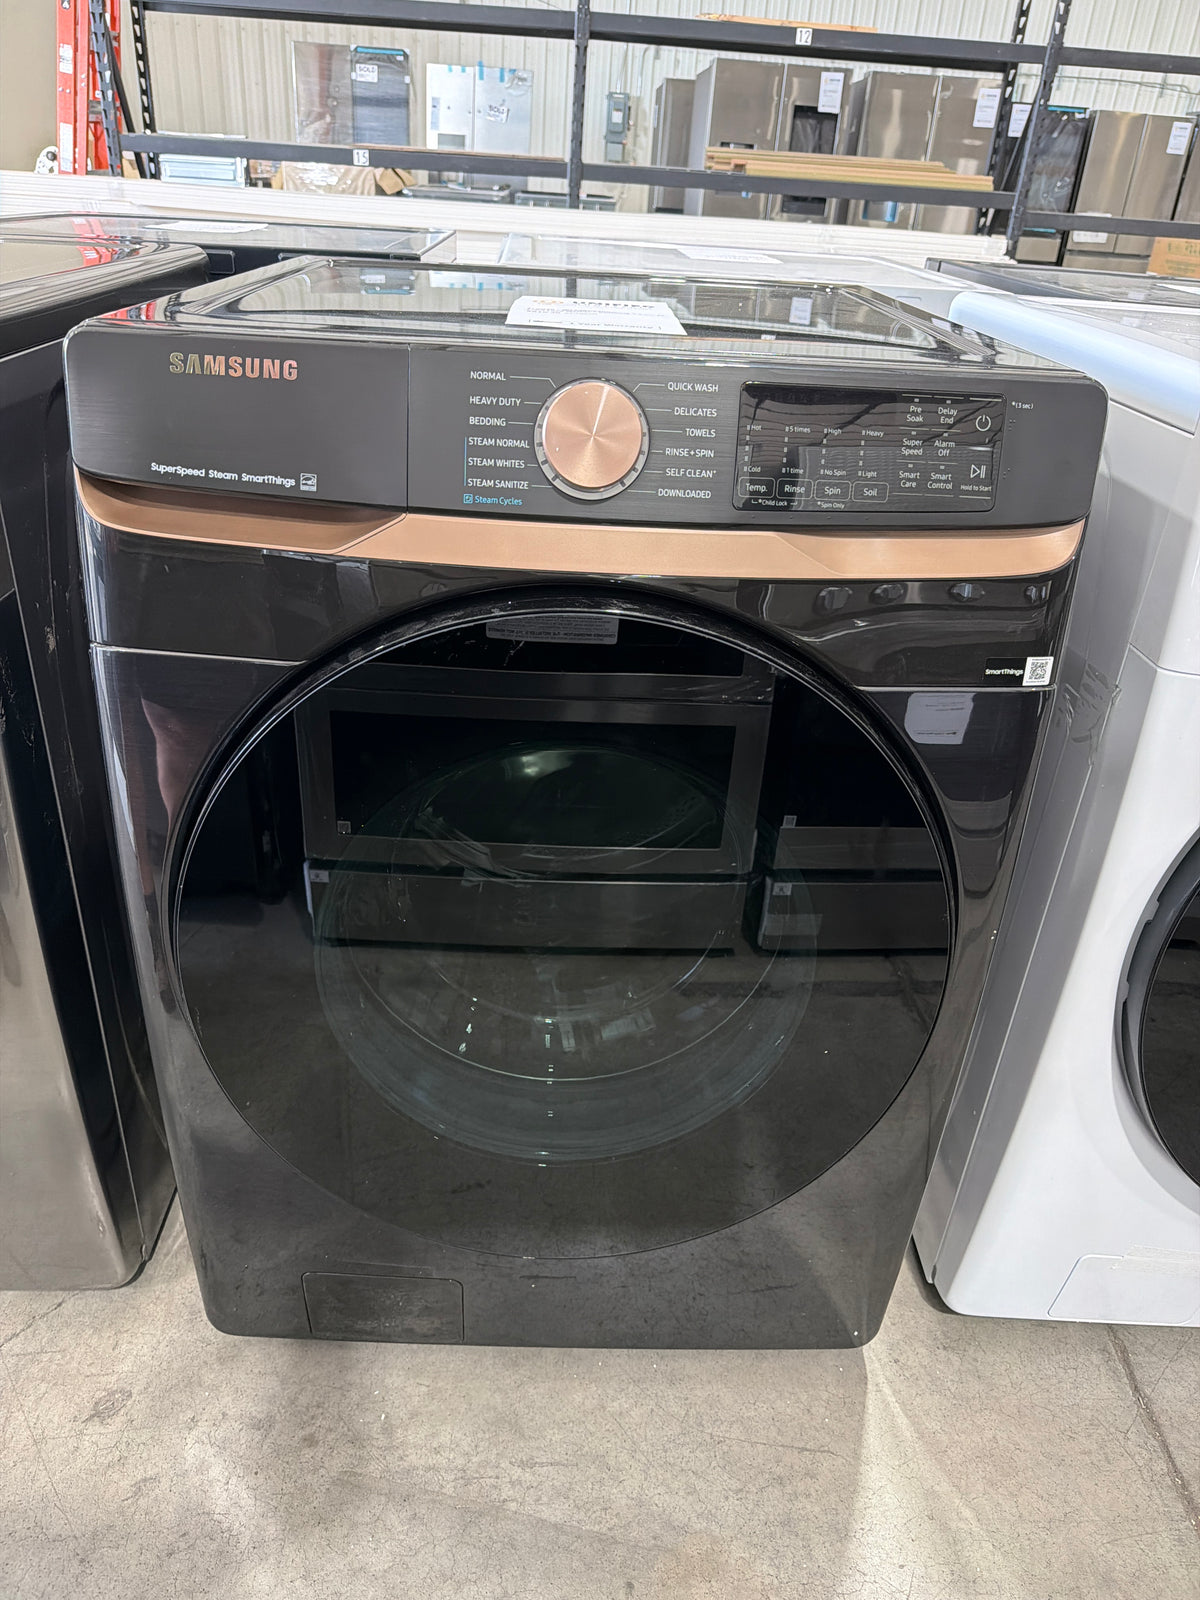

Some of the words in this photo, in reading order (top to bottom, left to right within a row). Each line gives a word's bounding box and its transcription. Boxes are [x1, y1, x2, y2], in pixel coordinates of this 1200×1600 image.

[799, 29, 811, 43] 12
[355, 151, 369, 164] 15
[169, 352, 298, 381] SAMSUNG
[470, 370, 506, 381] NORMAL
[667, 381, 693, 392] QUICK
[694, 383, 719, 393] WASH
[469, 395, 498, 406] HEAVY
[498, 396, 521, 407] DUTY
[674, 406, 717, 418] DELICATES
[910, 405, 922, 414] Pre
[938, 406, 958, 417] Delay
[469, 416, 506, 427] BEDDING
[906, 414, 924, 423] Soak
[940, 416, 954, 424] End
[685, 427, 716, 438] TOWELS
[794, 426, 811, 434] times
[866, 429, 884, 438] Heavy
[468, 436, 495, 447] STEAM
[496, 438, 530, 449] NORMAL
[902, 438, 923, 448] Super
[934, 440, 956, 448] Alarm
[901, 447, 923, 457] Speed
[938, 449, 950, 457] Off
[468, 457, 494, 467] STEAM
[495, 458, 525, 469] WHITES
[150, 462, 206, 478] SuperSpeed
[208, 469, 238, 481] Steam
[241, 472, 296, 488] SmartThings
[665, 467, 685, 477] SELF
[833, 469, 847, 477] Spin
[862, 470, 877, 478] Light
[899, 471, 920, 479] Smart
[930, 472, 952, 481] Smart
[467, 478, 494, 488] STEAM
[495, 479, 529, 490] SANITIZE
[746, 483, 768, 493] Temp.
[784, 484, 806, 494] Rinse
[900, 480, 917, 488] Care
[927, 481, 953, 490] Control
[658, 487, 712, 499] DOWNLOADED
[824, 486, 841, 495] Spin
[863, 487, 878, 496] Soil
[475, 495, 498, 505] Steam
[499, 496, 523, 507] Cycles
[984, 668, 1024, 677] SmartThings
